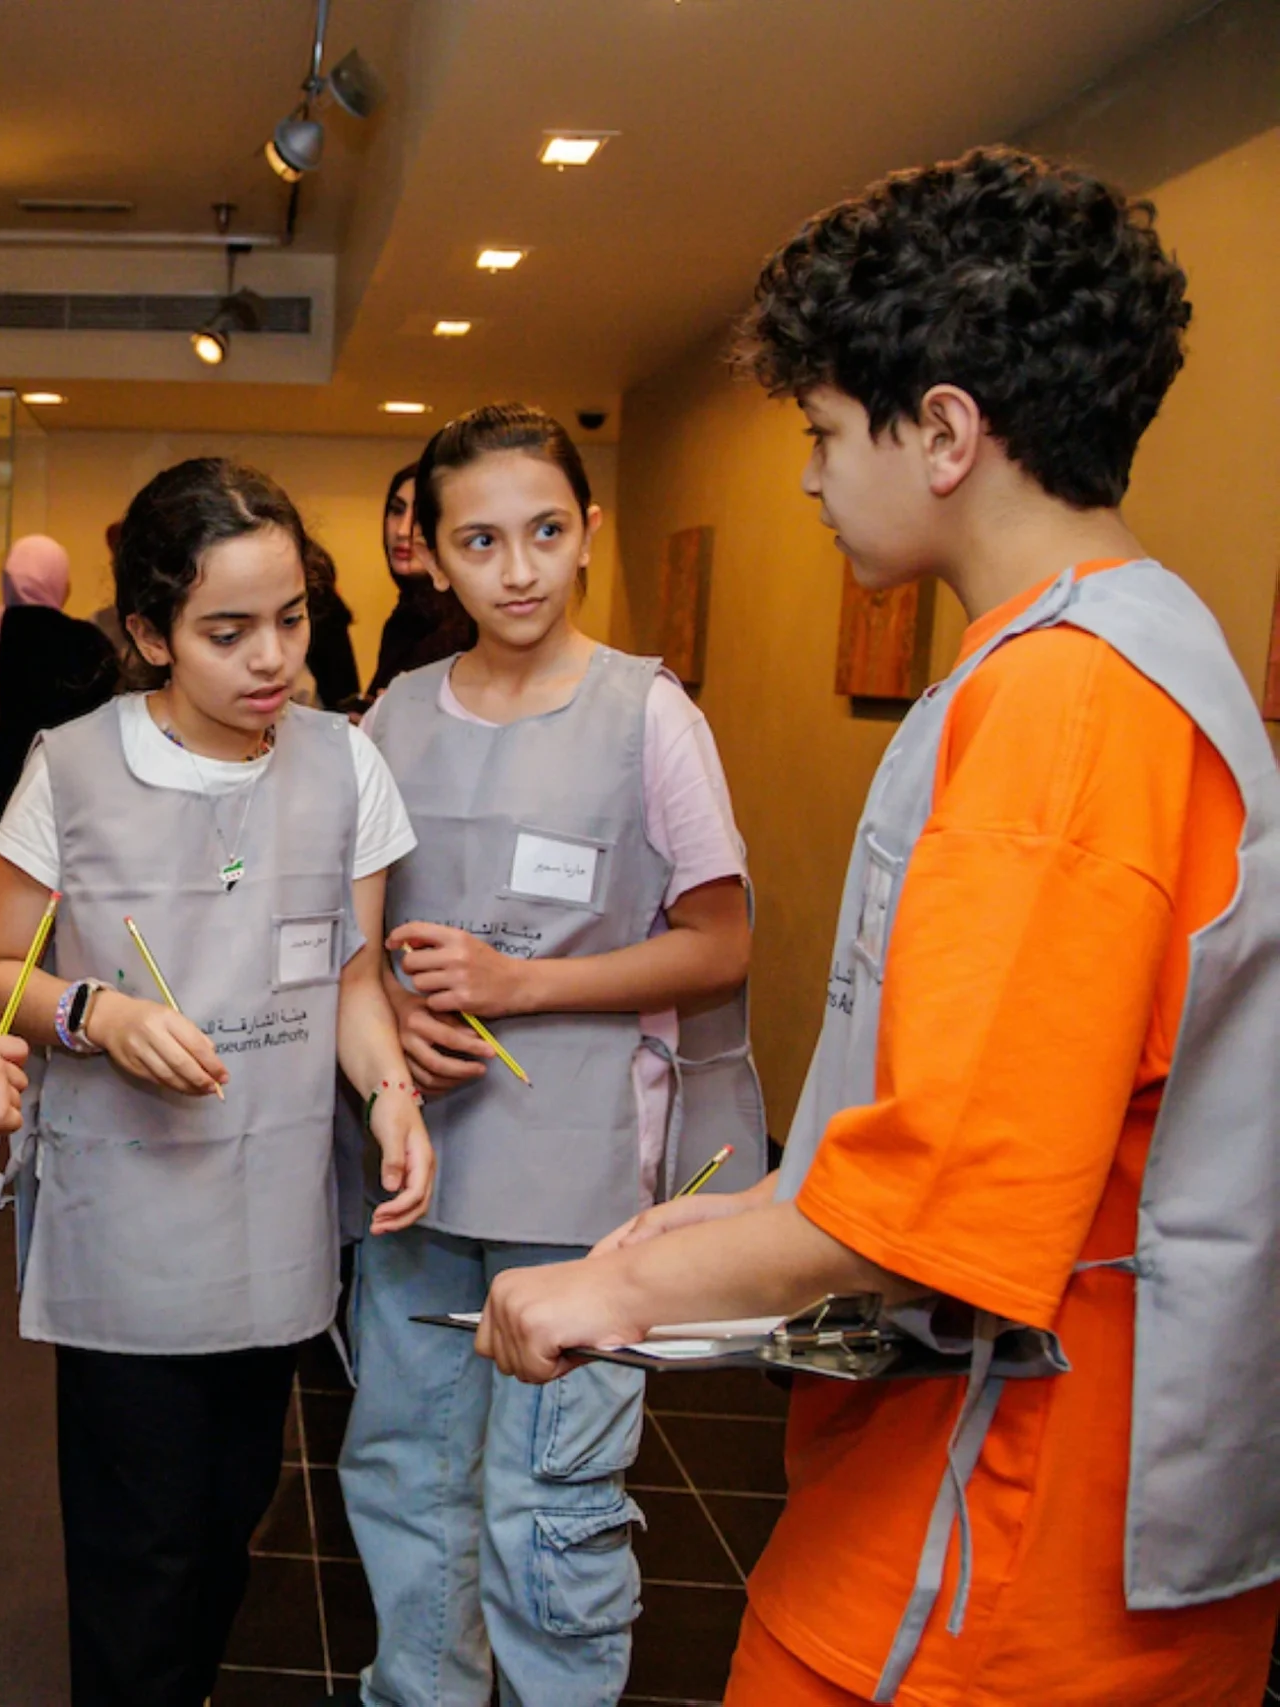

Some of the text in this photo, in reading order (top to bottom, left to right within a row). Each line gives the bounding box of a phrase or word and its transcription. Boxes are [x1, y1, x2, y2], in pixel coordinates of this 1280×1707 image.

[493, 940, 537, 960] thority
[215, 1028, 309, 1055] useums Authority
